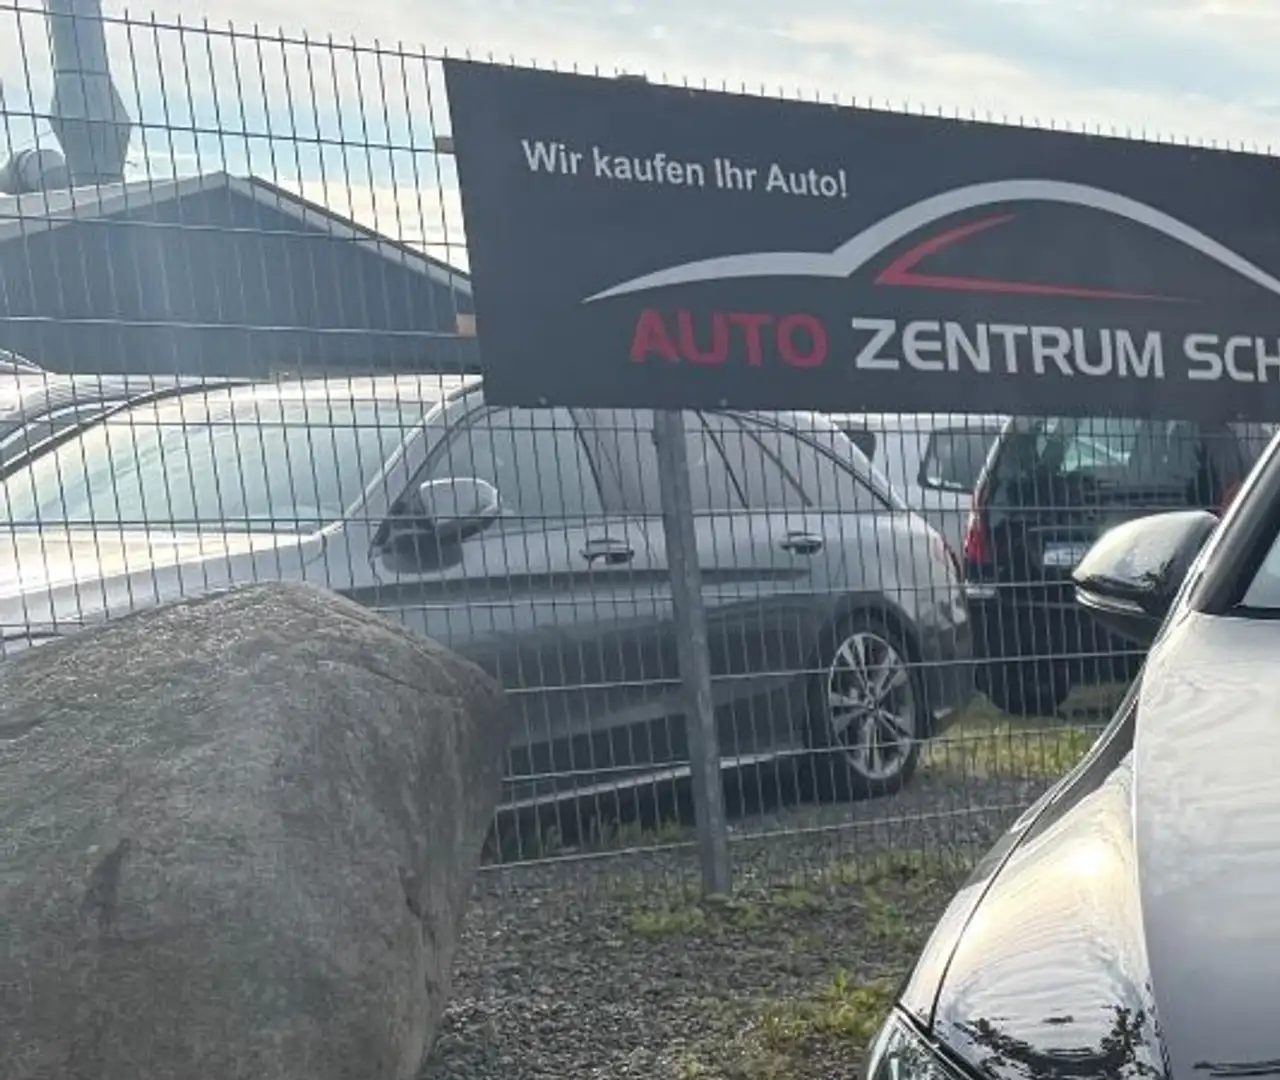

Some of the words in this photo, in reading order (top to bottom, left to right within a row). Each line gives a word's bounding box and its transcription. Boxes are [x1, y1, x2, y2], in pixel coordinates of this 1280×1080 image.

[521, 139, 582, 176] Wir
[593, 146, 705, 187] kaufen
[714, 157, 757, 191] Ihr
[765, 162, 849, 199] Auto!
[628, 308, 829, 368] AUTO
[851, 316, 1165, 379] ZENTRUM
